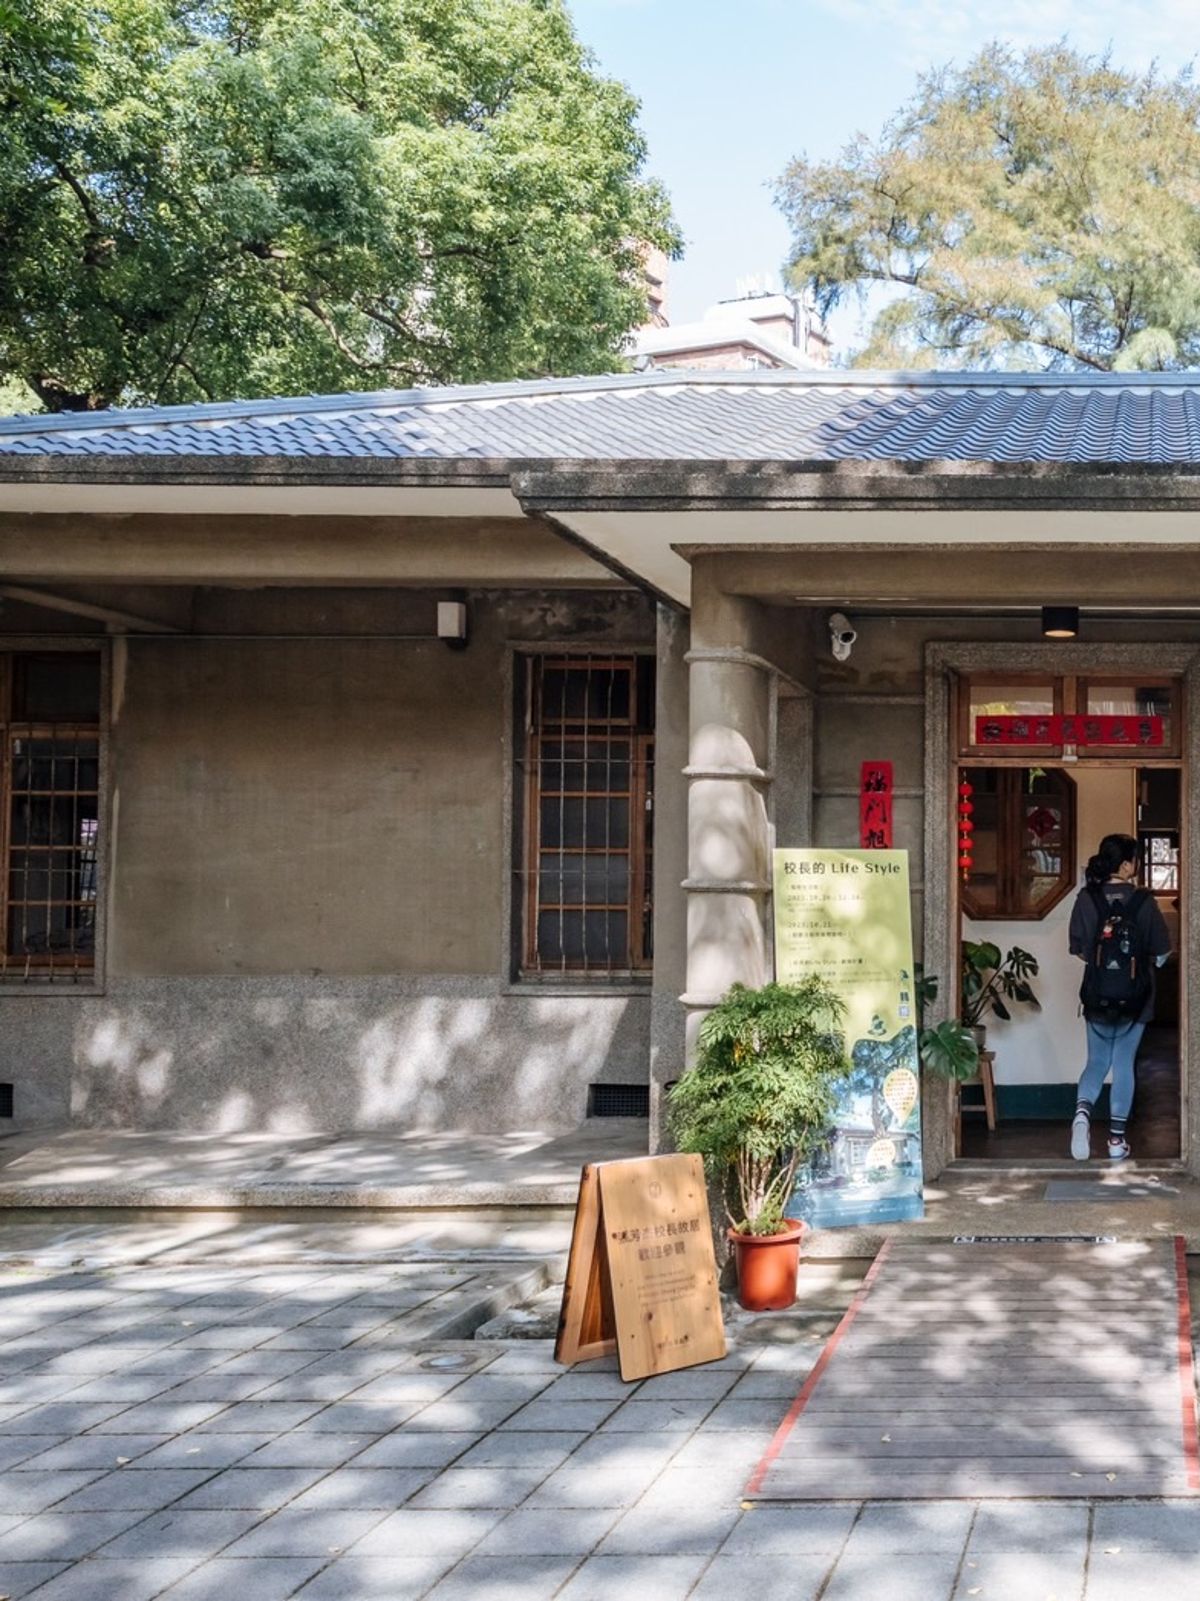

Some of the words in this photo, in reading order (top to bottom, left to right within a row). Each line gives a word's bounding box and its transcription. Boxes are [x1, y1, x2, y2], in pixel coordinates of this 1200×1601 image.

[784, 861, 826, 875] 校長的
[831, 862, 859, 874] Life
[864, 862, 901, 876] Style
